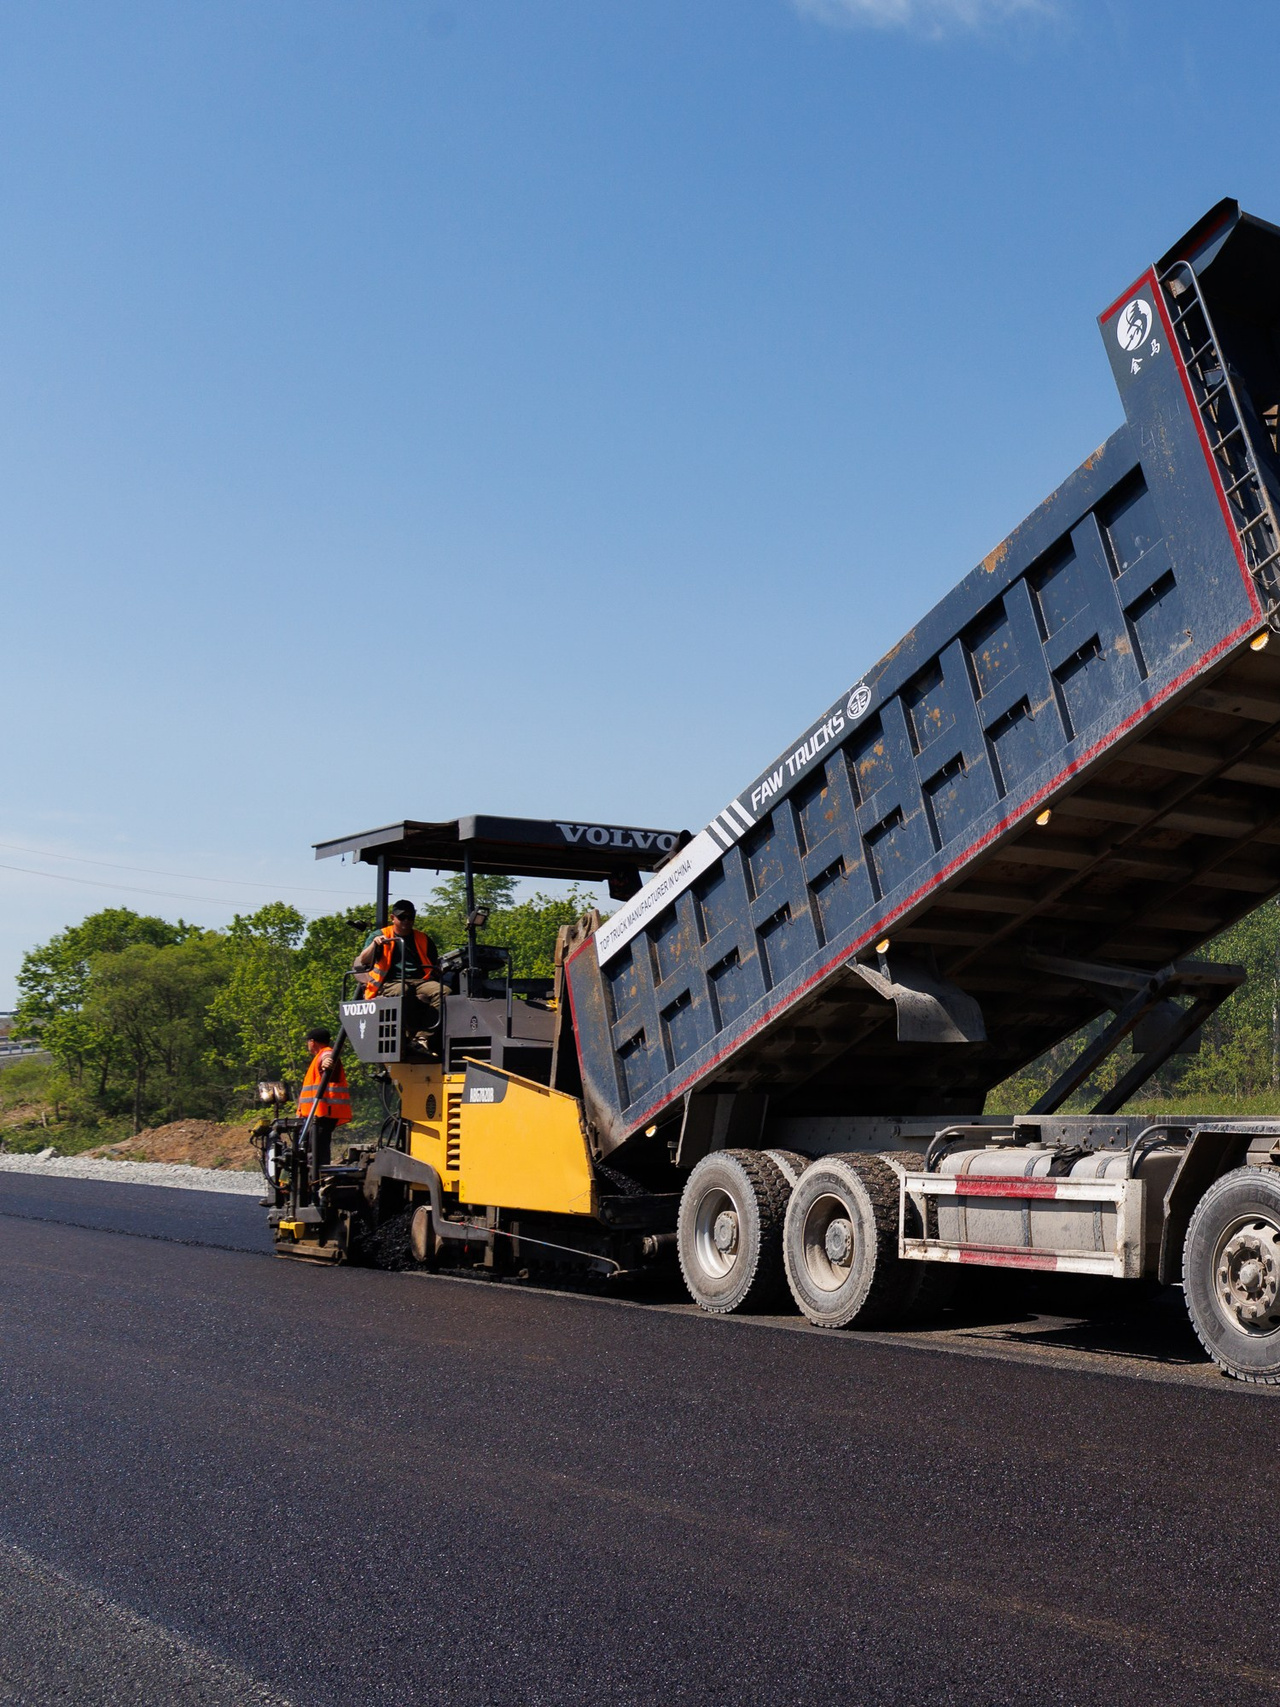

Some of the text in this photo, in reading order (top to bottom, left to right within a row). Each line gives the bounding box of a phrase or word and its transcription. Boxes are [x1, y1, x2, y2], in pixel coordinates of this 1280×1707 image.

[751, 709, 846, 812] FAW TRUCKS
[556, 823, 681, 852] VOLVO
[599, 933, 611, 953] TOP
[609, 919, 629, 943] TRUCK
[627, 880, 670, 927] MANUFACTURER
[673, 859, 693, 882] CHINA
[342, 1002, 377, 1016] VOLVO
